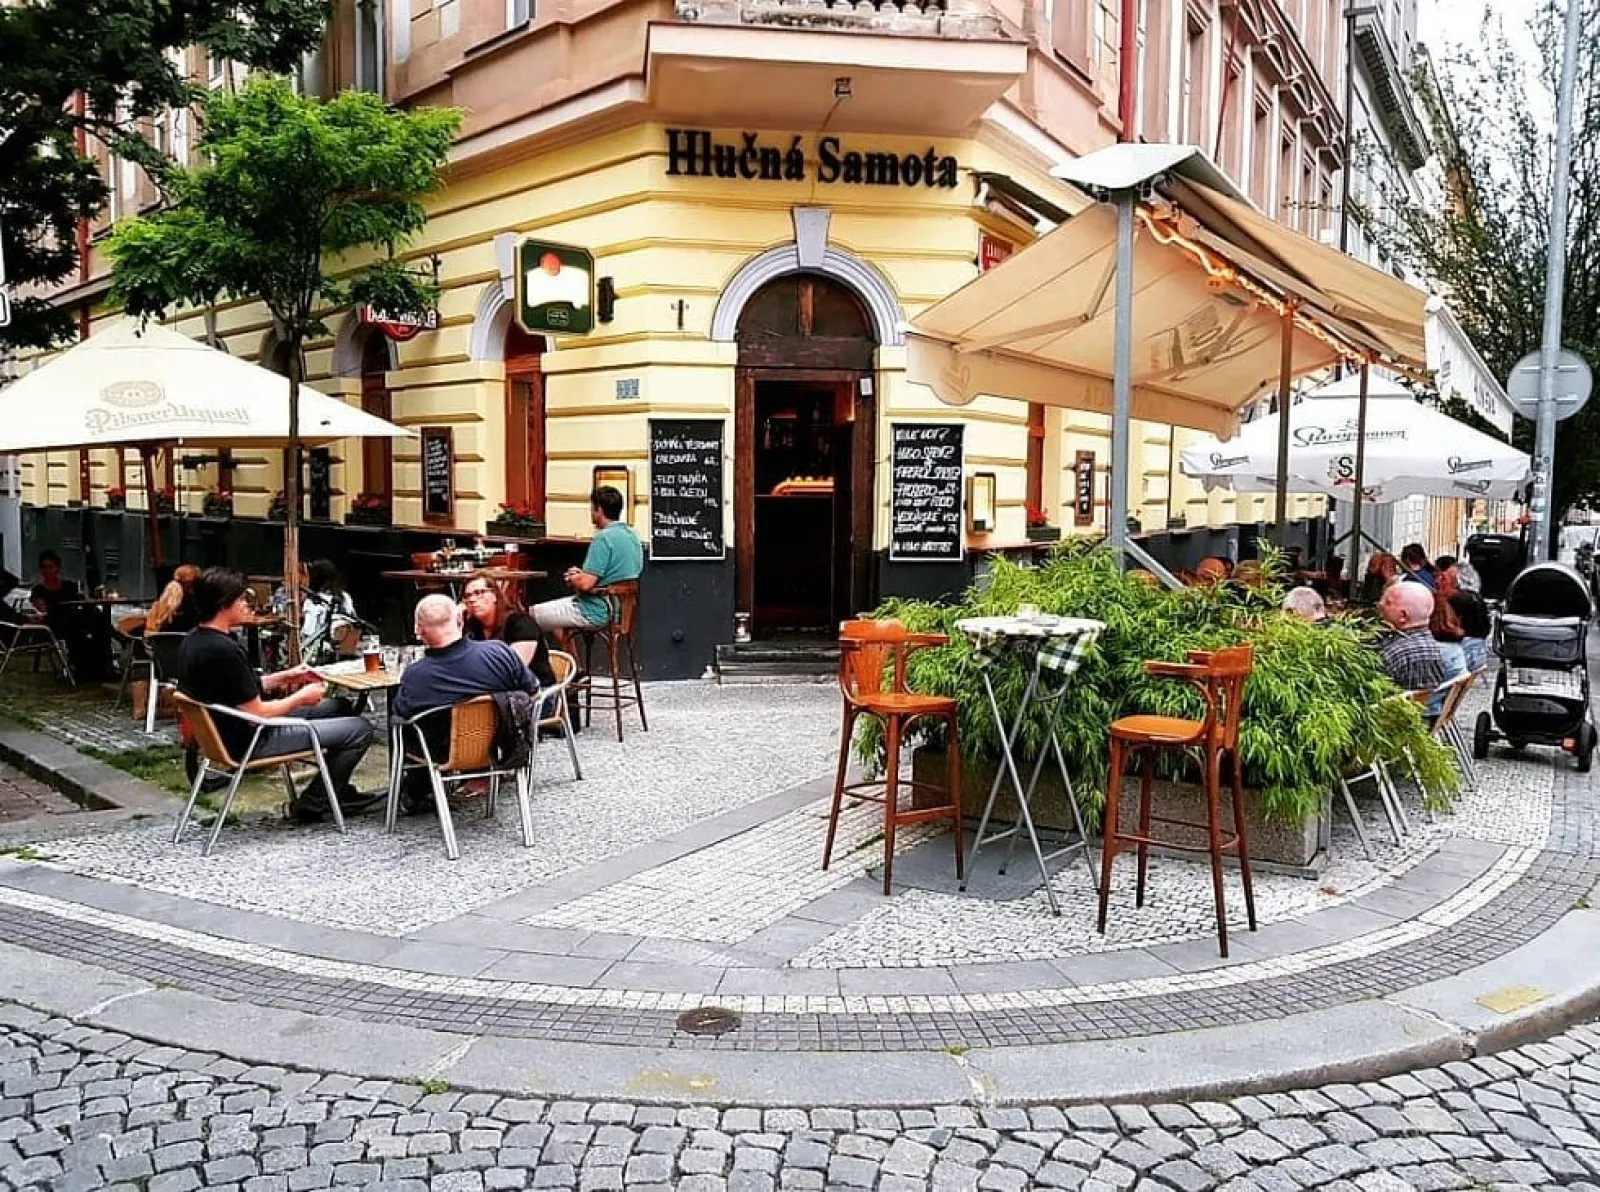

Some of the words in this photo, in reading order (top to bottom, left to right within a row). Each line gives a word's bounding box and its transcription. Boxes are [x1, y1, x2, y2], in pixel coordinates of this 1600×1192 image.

[665, 128, 805, 181] Hlučná
[817, 136, 958, 188] Samota
[85, 407, 172, 435] Pilsner
[167, 403, 250, 426] Urquell
